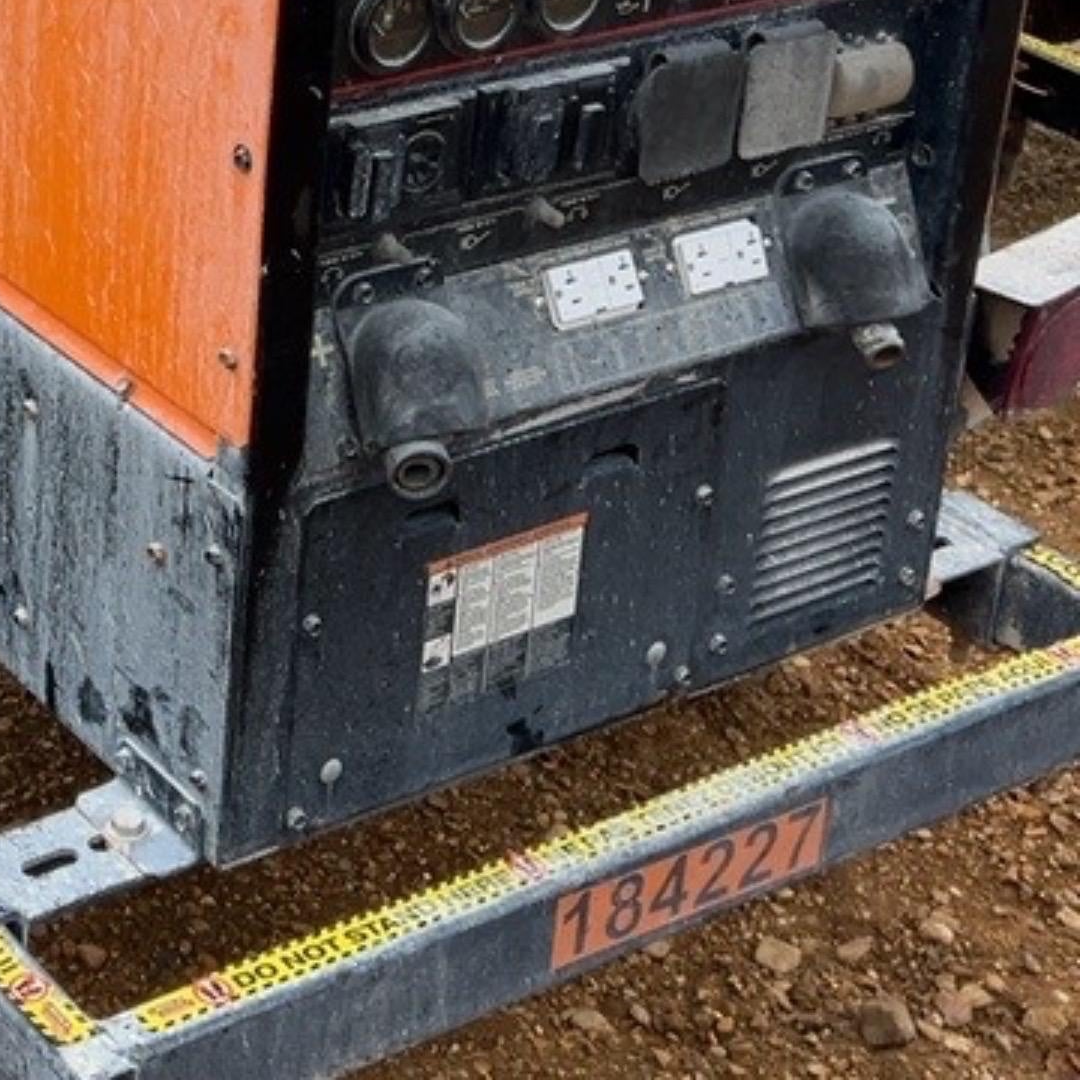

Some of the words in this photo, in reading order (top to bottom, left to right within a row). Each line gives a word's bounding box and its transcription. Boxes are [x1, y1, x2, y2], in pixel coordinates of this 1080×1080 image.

[563, 805, 820, 956] 184227
[233, 962, 277, 988] DO
[281, 937, 341, 969] NOT
